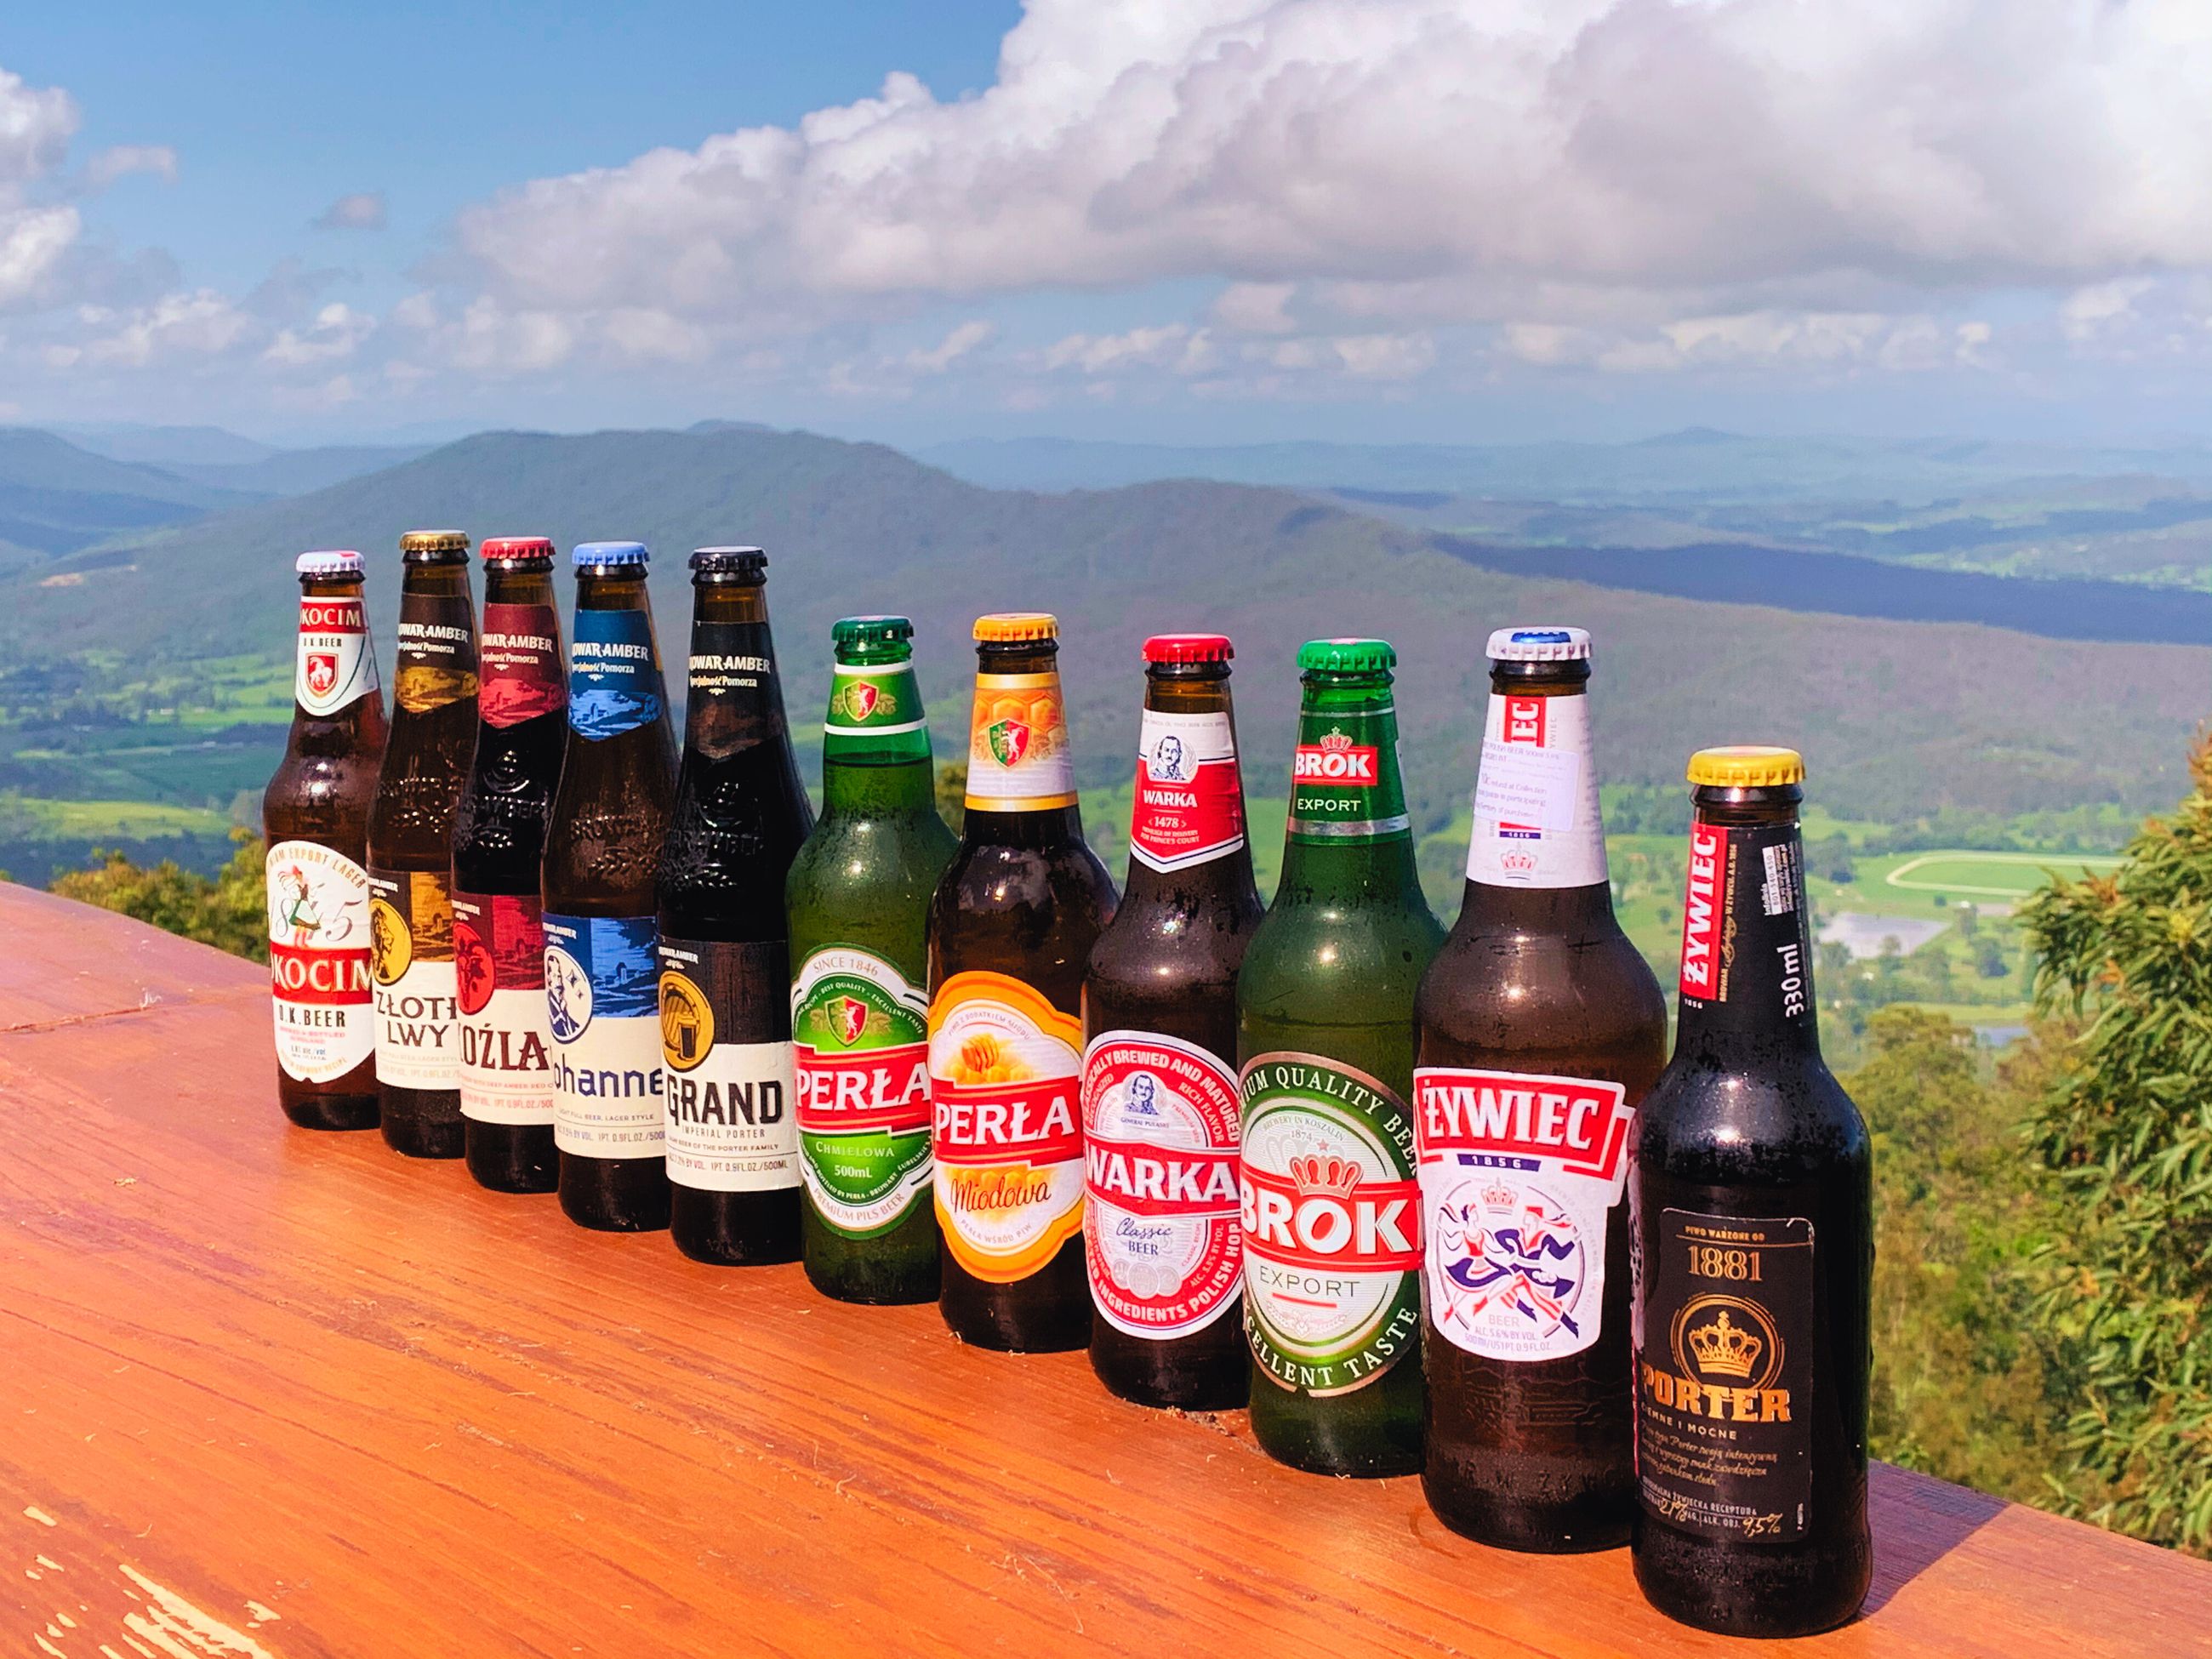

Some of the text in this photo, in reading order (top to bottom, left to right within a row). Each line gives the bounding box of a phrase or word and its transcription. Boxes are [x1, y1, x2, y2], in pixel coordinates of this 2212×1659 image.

[300, 607, 361, 627] KOCIM
[572, 642, 603, 657] OWAR
[689, 655, 723, 670] OWAR
[601, 663, 635, 674] Pomorza
[722, 676, 758, 687] Pomorza
[1294, 752, 1371, 778] BROK
[1143, 790, 1198, 808] WARKA
[1297, 798, 1361, 812] EXPORT
[1154, 816, 1179, 829] 1478
[289, 847, 328, 864] EXPORT
[333, 859, 366, 888] LAGER
[1684, 832, 1717, 987] ŻYWIEC
[813, 957, 878, 977] SINCE 1846
[835, 982, 866, 993] QUALITY
[871, 994, 906, 1018] EXCELLENT
[908, 1013, 924, 1034] TASTE
[387, 1020, 449, 1047] LWY
[459, 1023, 550, 1071] OŹLA
[667, 1073, 784, 1126] GRAND
[795, 1062, 932, 1111] PERŁA
[1112, 1049, 1170, 1069] BREWED
[1169, 1058, 1203, 1083] AND
[1200, 1076, 1240, 1143] MATURED
[1275, 1067, 1384, 1115] QUALITY
[935, 1096, 1075, 1145] PERŁA
[1177, 1081, 1204, 1105] RICH
[1201, 1101, 1225, 1143] FLAVOR
[1422, 1079, 1600, 1150] ŻYWIEC
[681, 1126, 766, 1138] IMPERIAL PORTER
[1291, 1129, 1313, 1141] 1874
[1305, 1118, 1344, 1142] KOSZALIN
[834, 1164, 874, 1178] 500mL
[1084, 1138, 1240, 1203] WARKA
[1472, 1154, 1522, 1169] 1856
[814, 1188, 905, 1221] PREMIUM PILS BEER
[950, 1176, 1052, 1214] Miodowa
[1115, 1217, 1174, 1239] Classic
[1240, 1177, 1414, 1255] BROK
[1685, 1225, 1765, 1241] PIWO WARZONE OD
[1128, 1240, 1159, 1256] BEER
[1687, 1245, 1763, 1282] 1881
[1097, 1280, 1189, 1322] INGREDIENTS
[1189, 1260, 1235, 1313] POLISH
[1259, 1265, 1360, 1297] EXPORT
[1488, 1314, 1520, 1327] BEER
[1343, 1308, 1418, 1379] TASTE
[1640, 1362, 1793, 1423] PORTER
[1687, 1424, 1737, 1440] MOCNE
[1710, 1502, 1757, 1516] RECEPTURA
